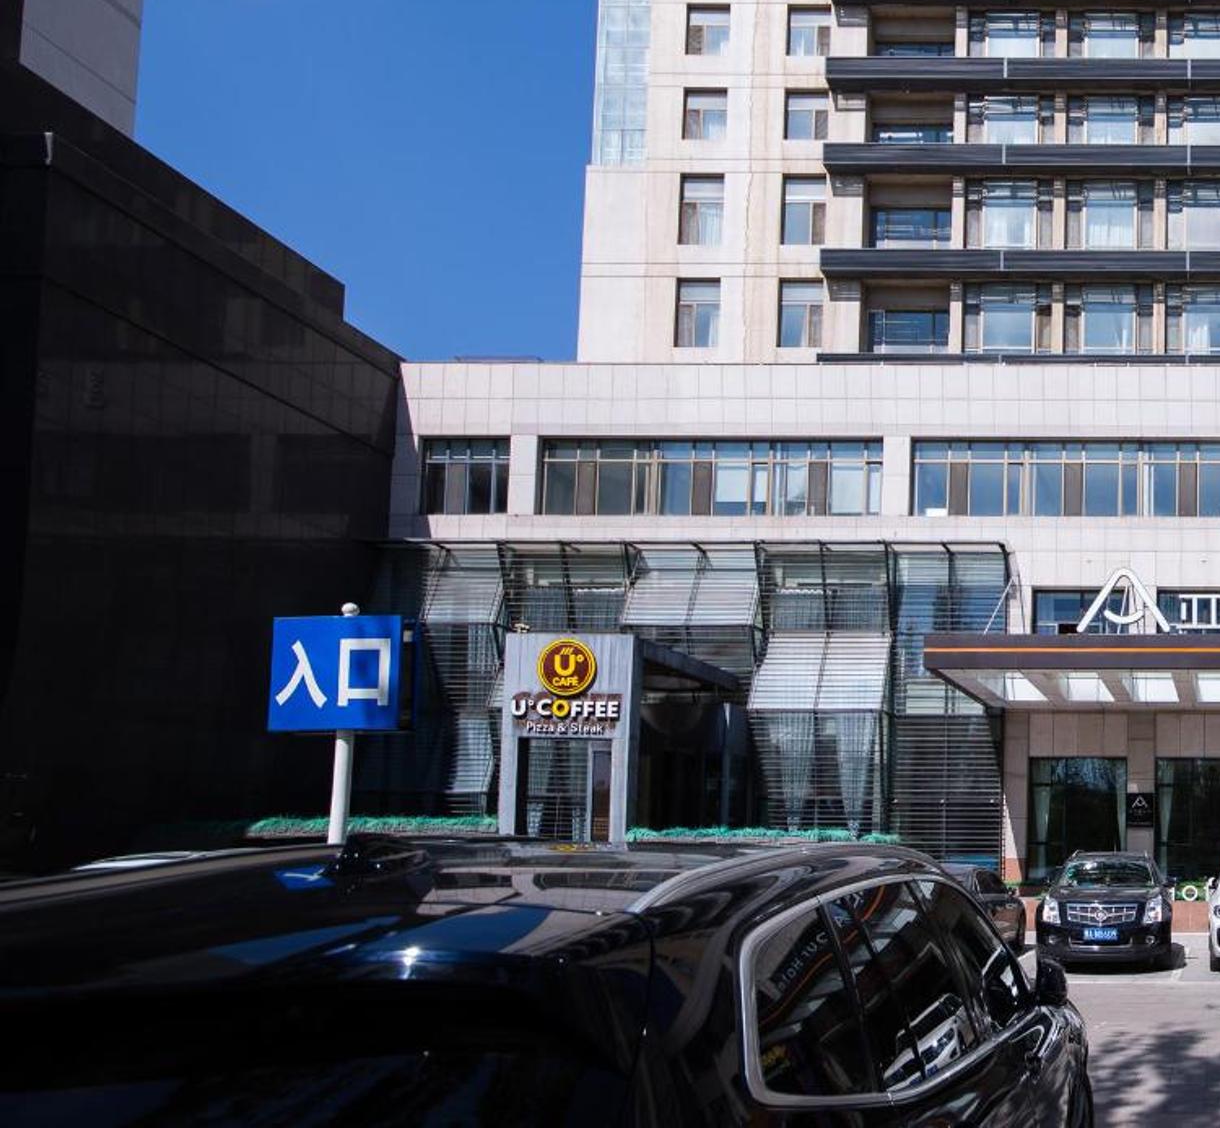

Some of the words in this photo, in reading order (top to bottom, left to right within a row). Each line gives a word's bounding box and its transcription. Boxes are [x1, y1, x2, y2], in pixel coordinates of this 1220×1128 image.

[275, 638, 391, 708] 入口
[526, 721, 556, 734] Pizza
[557, 722, 567, 733] &
[570, 721, 604, 734] Steak
